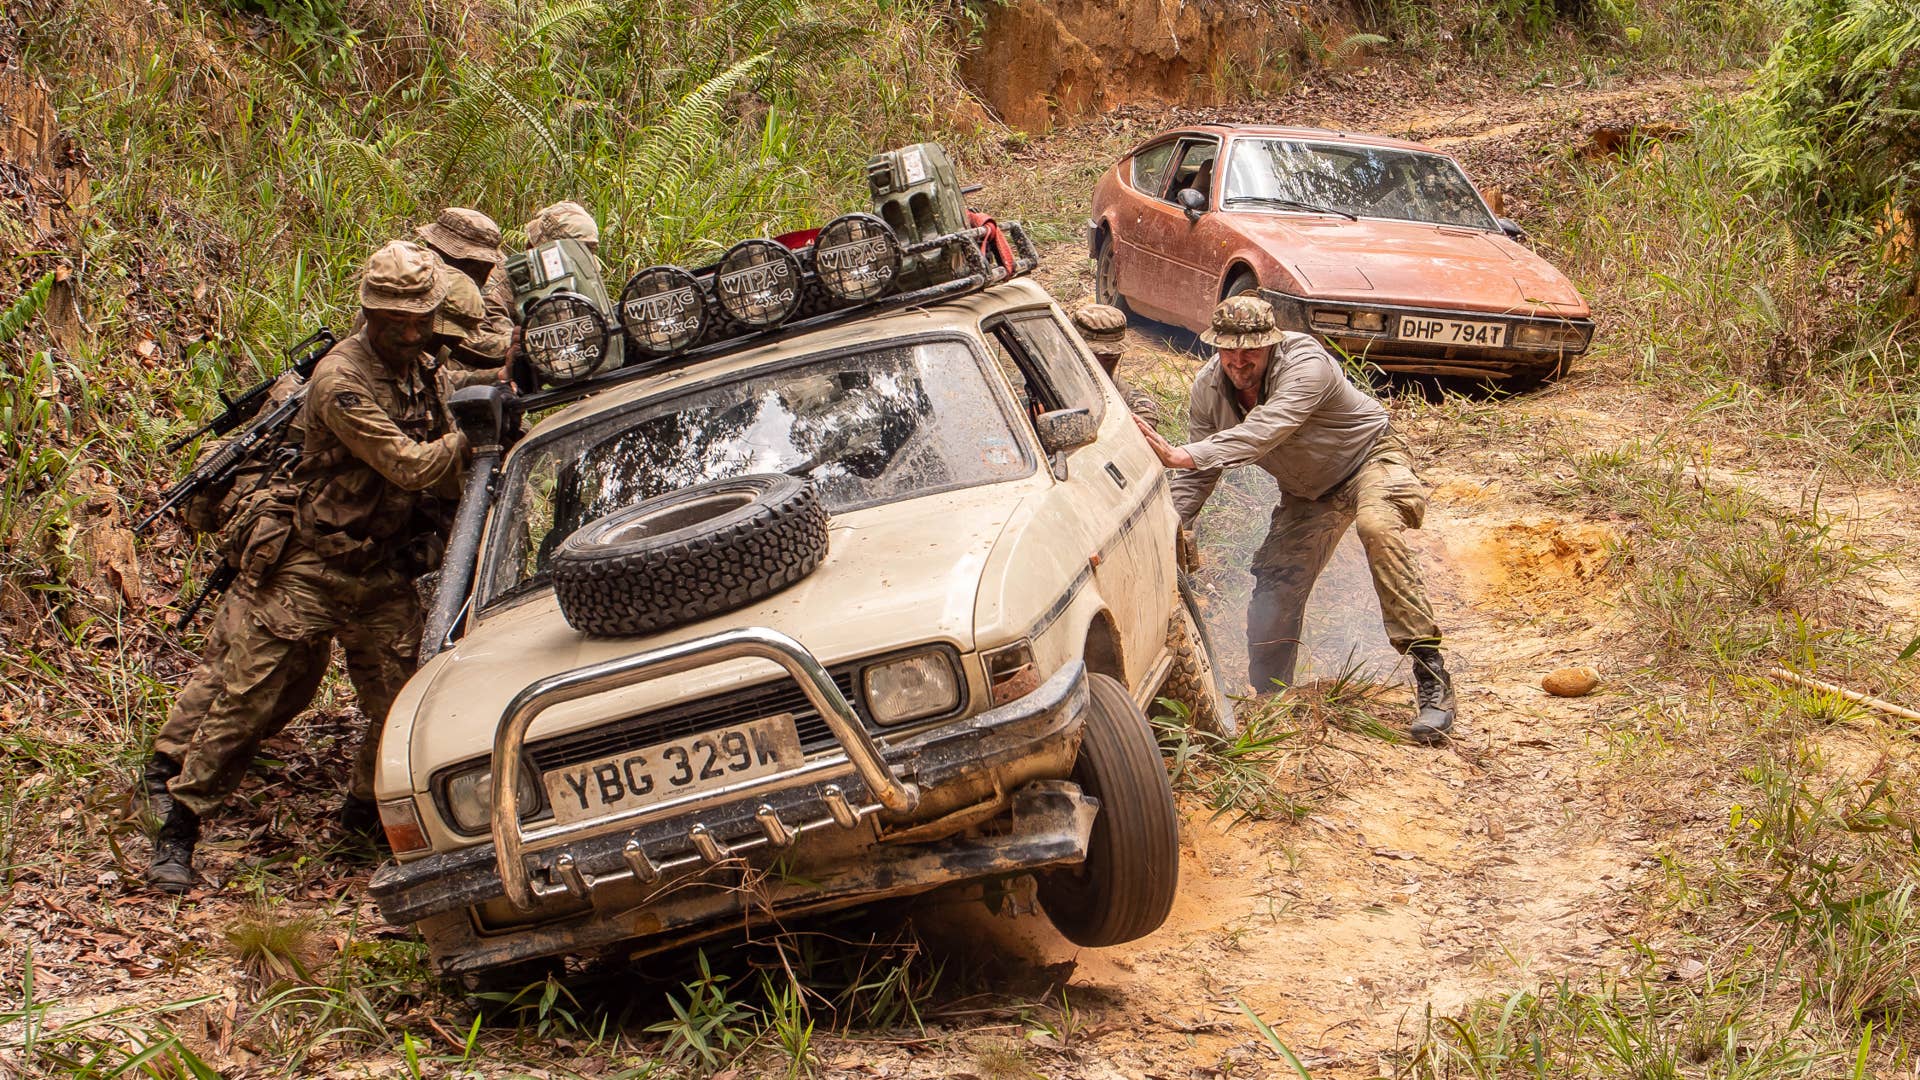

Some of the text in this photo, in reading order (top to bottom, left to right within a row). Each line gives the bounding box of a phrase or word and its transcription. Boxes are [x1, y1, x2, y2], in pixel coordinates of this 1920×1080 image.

[818, 236, 887, 270] WIPAC
[719, 259, 789, 294] WIPAC
[627, 286, 695, 321] WIPAC
[754, 288, 794, 308] 4x4
[527, 315, 595, 350] WIPAC
[659, 316, 700, 335] 4x4
[1402, 319, 1503, 344] DHP 794T
[563, 755, 654, 810] YBG
